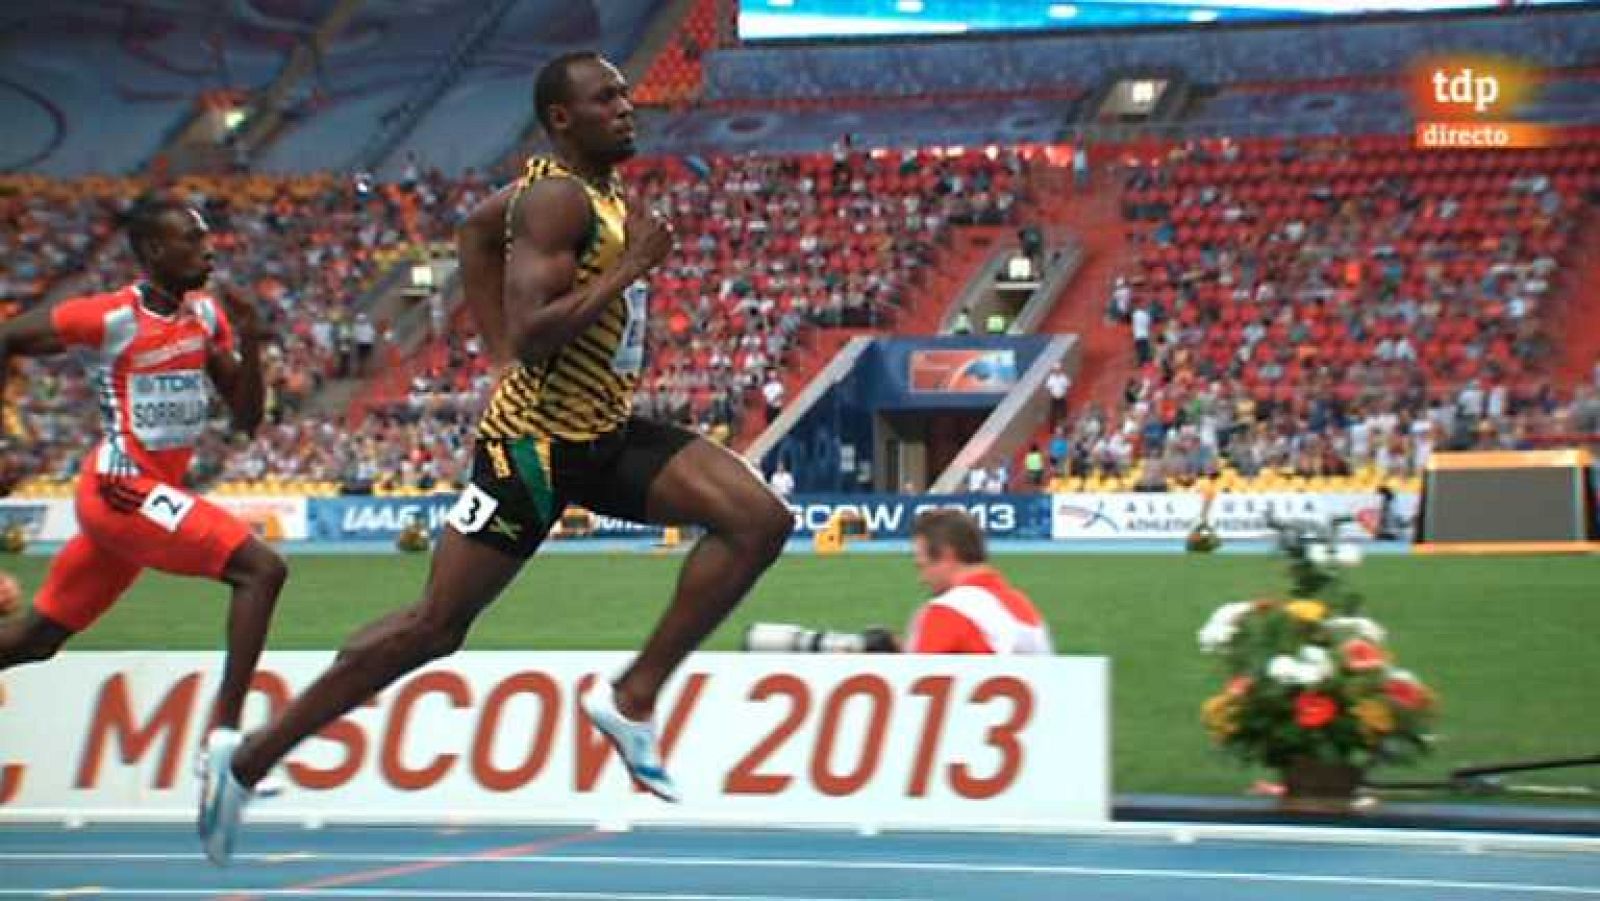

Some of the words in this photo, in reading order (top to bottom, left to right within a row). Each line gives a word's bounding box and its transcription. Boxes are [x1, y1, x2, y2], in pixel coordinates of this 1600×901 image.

[151, 493, 184, 516] 2
[460, 496, 481, 525] 3
[915, 504, 1016, 531] 13
[722, 672, 1037, 799] 2013
